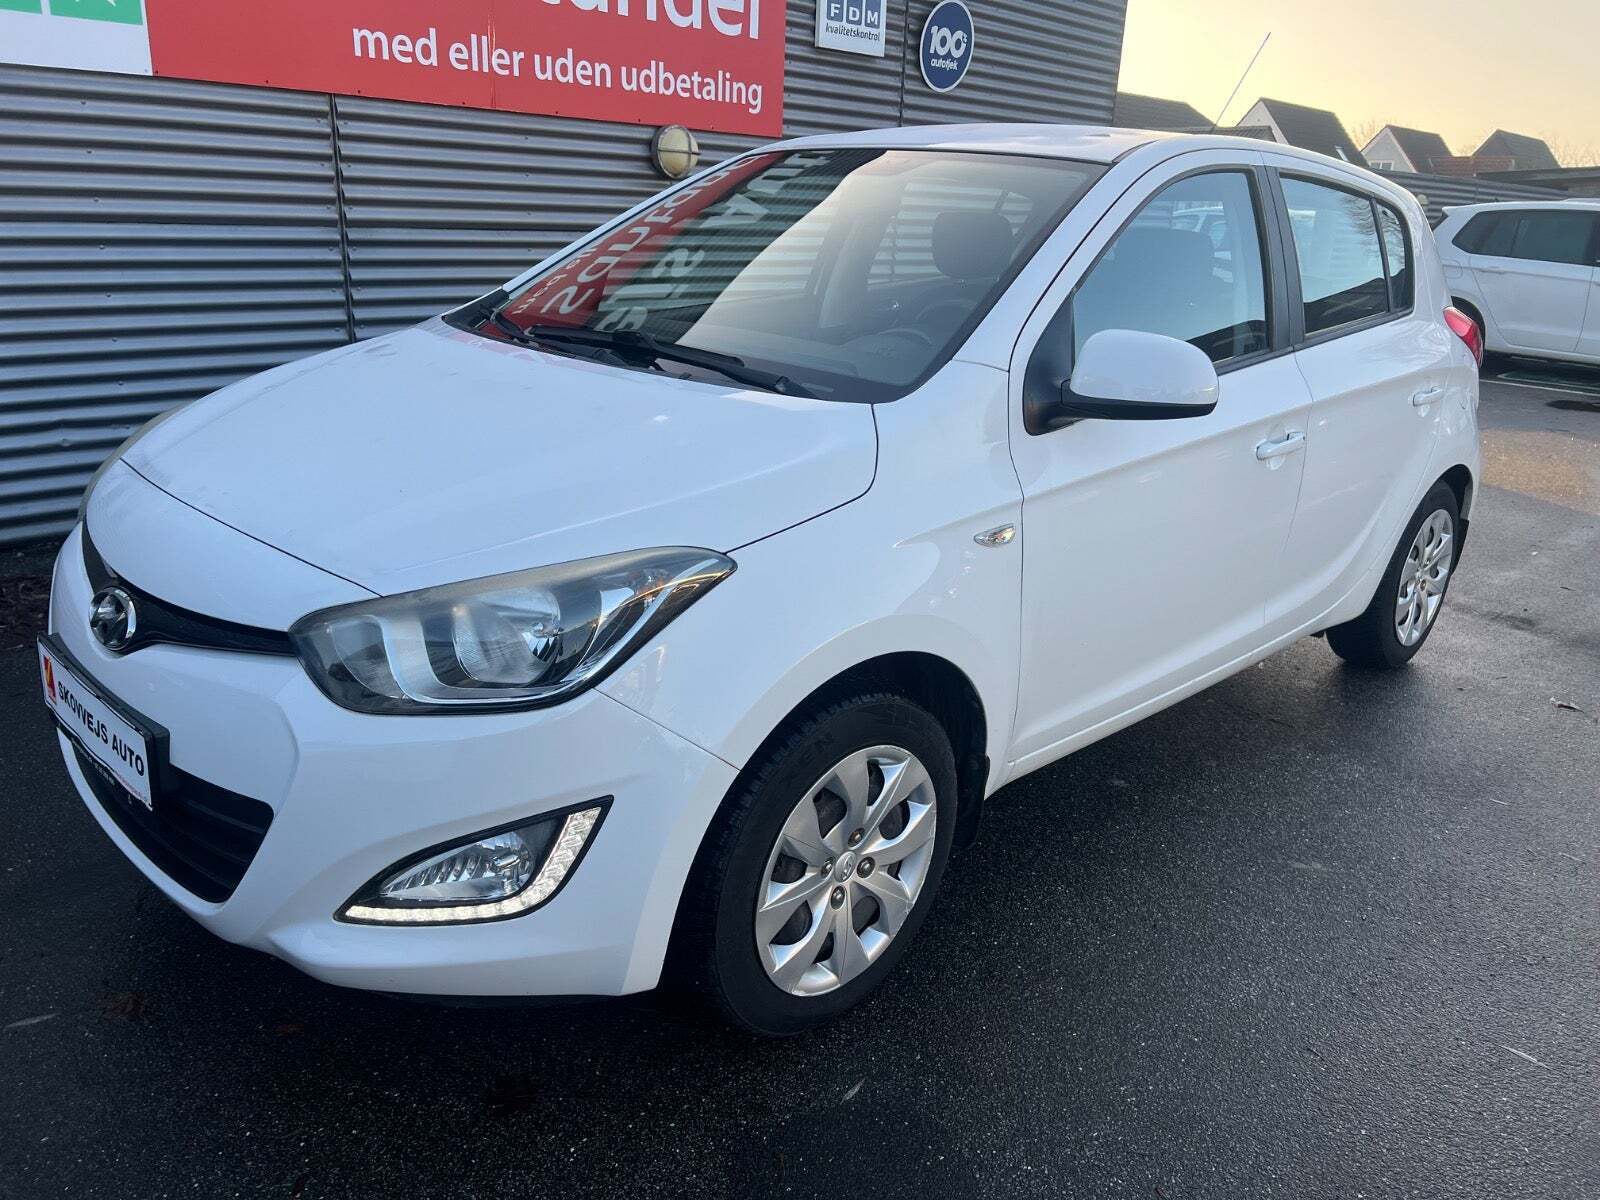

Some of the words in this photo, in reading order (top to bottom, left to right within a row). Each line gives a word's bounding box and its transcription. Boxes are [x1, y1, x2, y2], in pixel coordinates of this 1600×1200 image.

[826, 23, 880, 42] kvalitetskontrol
[830, 4, 878, 25] FDM
[352, 27, 438, 67] med
[449, 33, 525, 77] eller
[534, 48, 612, 88] uden
[621, 60, 762, 114] udbetaling
[57, 681, 109, 745] SKOVVEJS
[111, 734, 145, 777] AUTO
